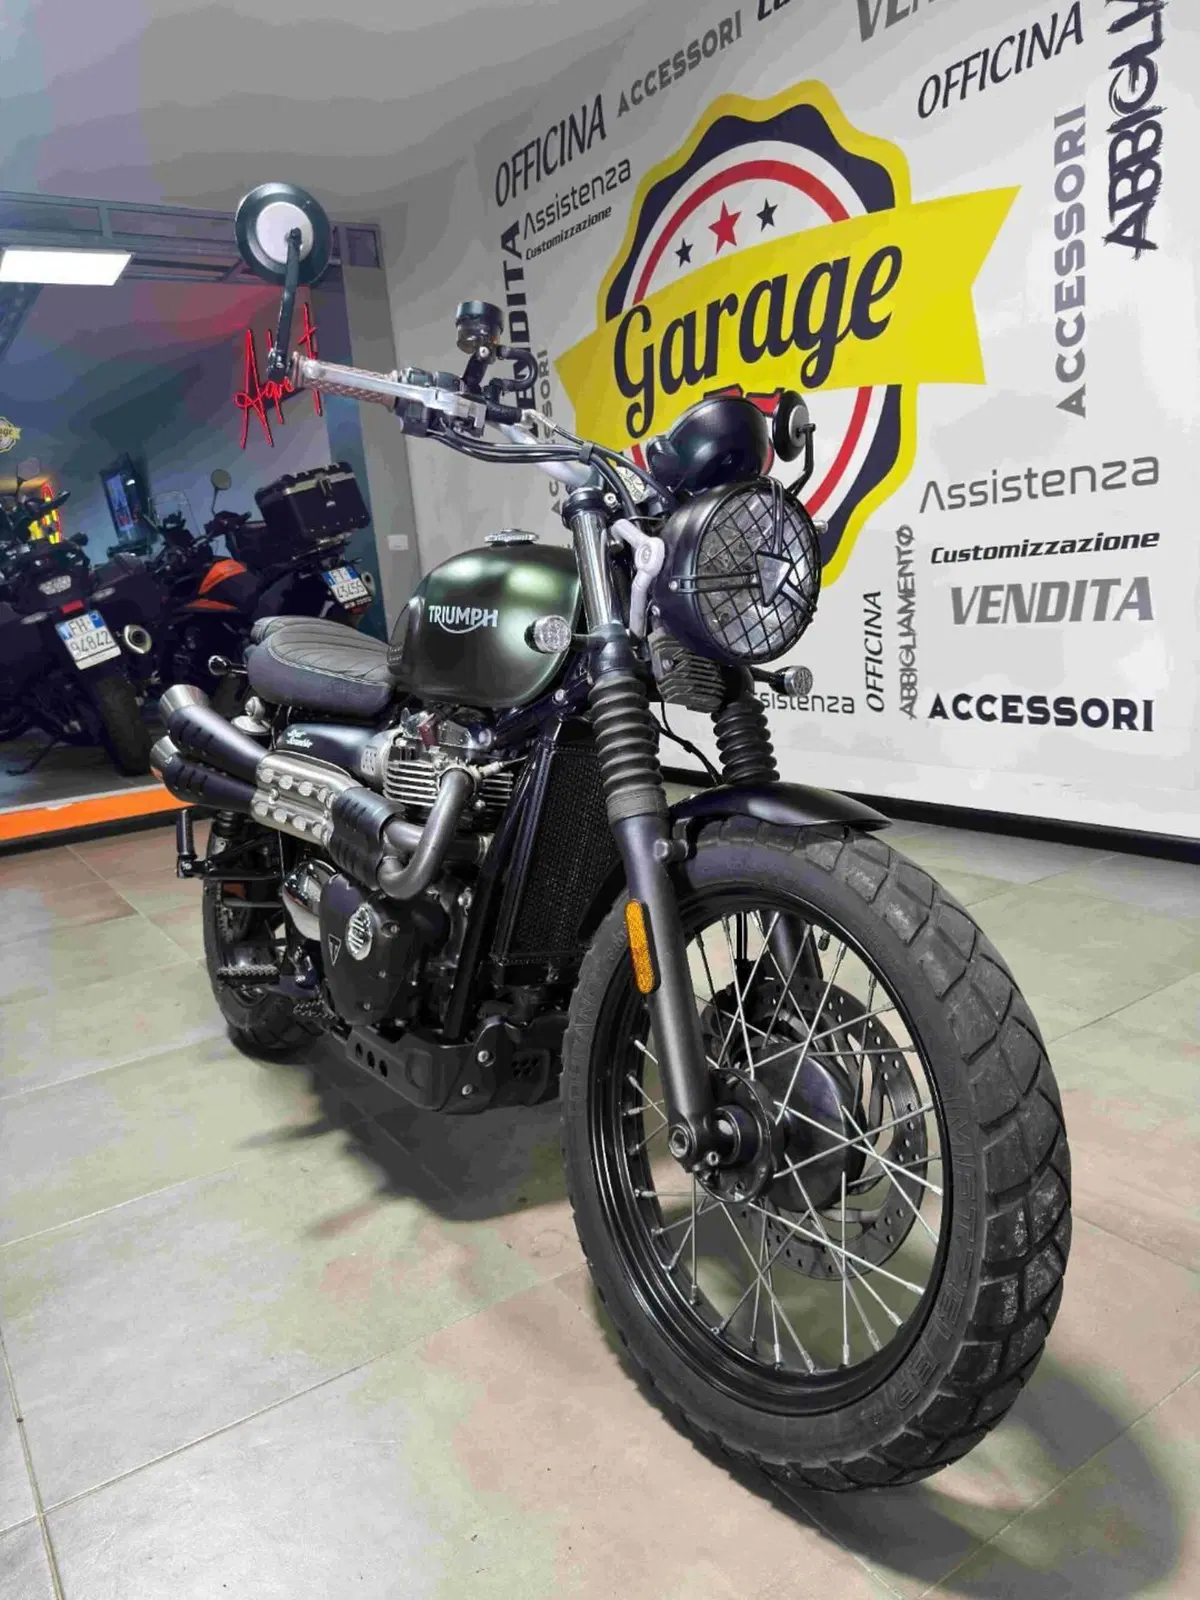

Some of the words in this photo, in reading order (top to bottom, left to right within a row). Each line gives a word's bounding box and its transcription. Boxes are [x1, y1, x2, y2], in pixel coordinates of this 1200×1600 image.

[615, 9, 743, 119] ACCESSORI
[916, 0, 1085, 120] OFFICINA
[494, 93, 607, 208] OFFICINA
[1101, 0, 1169, 261] ABBIGLI
[522, 157, 633, 241] Assistenza
[525, 205, 613, 261] Customizzazione
[1053, 104, 1086, 419] ACCESSORI
[613, 244, 903, 440] Garage
[919, 455, 1160, 514] Assistenza
[930, 531, 1161, 564] Customizzazione
[428, 604, 499, 633] TRIUMPH
[950, 576, 1154, 625] VENDITA
[862, 590, 885, 714] OFFICINA
[927, 692, 1155, 732] ACCESSORI
